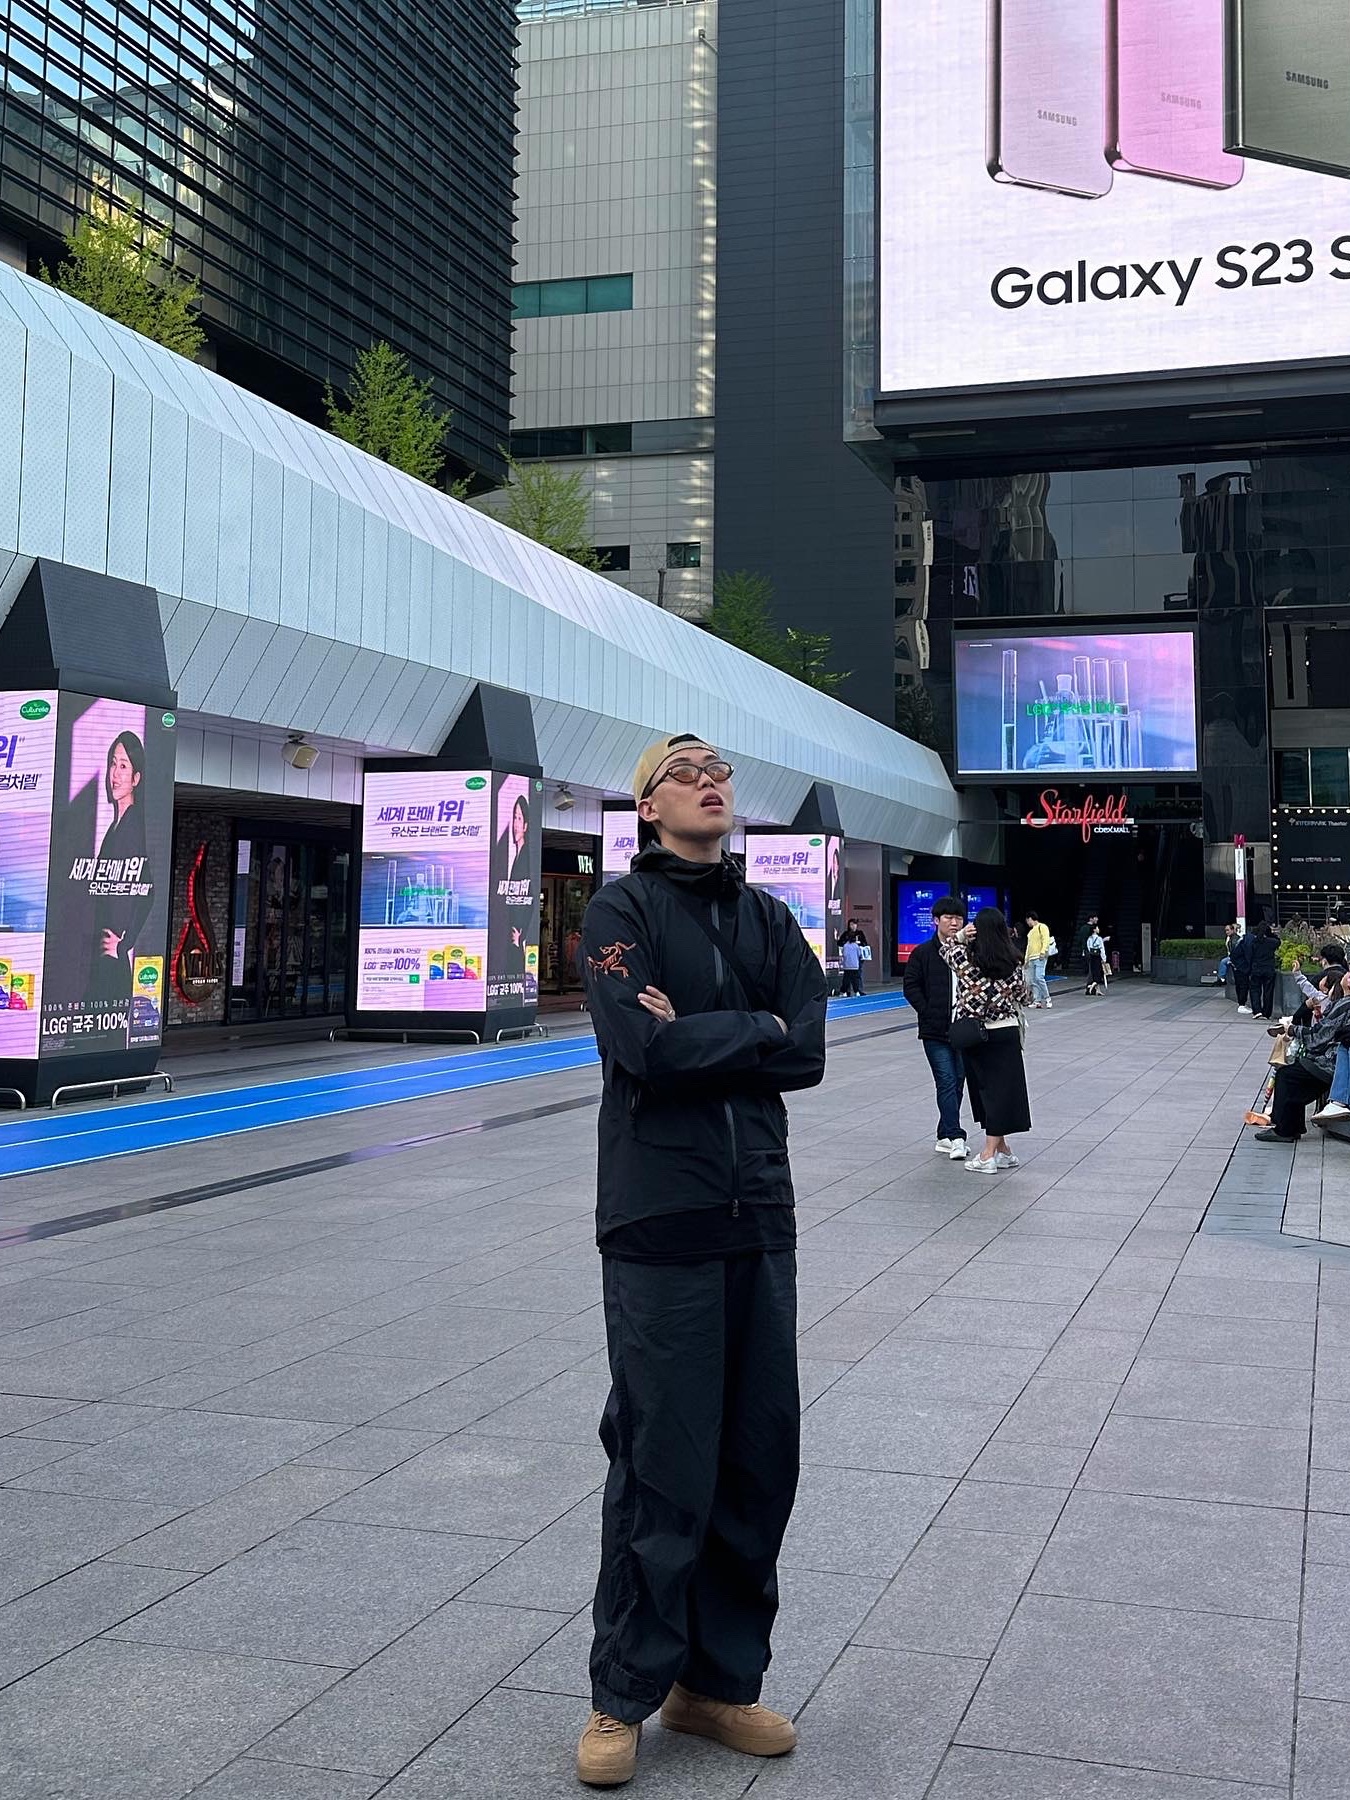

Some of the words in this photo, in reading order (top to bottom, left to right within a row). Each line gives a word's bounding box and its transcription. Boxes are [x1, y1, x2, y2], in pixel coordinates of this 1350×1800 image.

[1285, 71, 1330, 90] SAMSUNG
[1160, 92, 1202, 110] SAMSUNG
[1036, 109, 1078, 127] SAMSUNG
[990, 257, 1203, 309] Galaxy
[1214, 238, 1314, 289] S23
[377, 806, 405, 821] 세계
[407, 805, 435, 821] 판매
[437, 800, 464, 822] 1위
[1026, 789, 1128, 843] Starfield
[391, 826, 419, 837] 유산균
[419, 826, 450, 837] 브랜드
[792, 852, 809, 865] 1위
[68, 858, 97, 880] 세계
[96, 859, 124, 881] 판매
[122, 856, 145, 882] 1위
[394, 957, 420, 970] 100%
[72, 1014, 94, 1033] 균주
[96, 1012, 128, 1031] 100%
